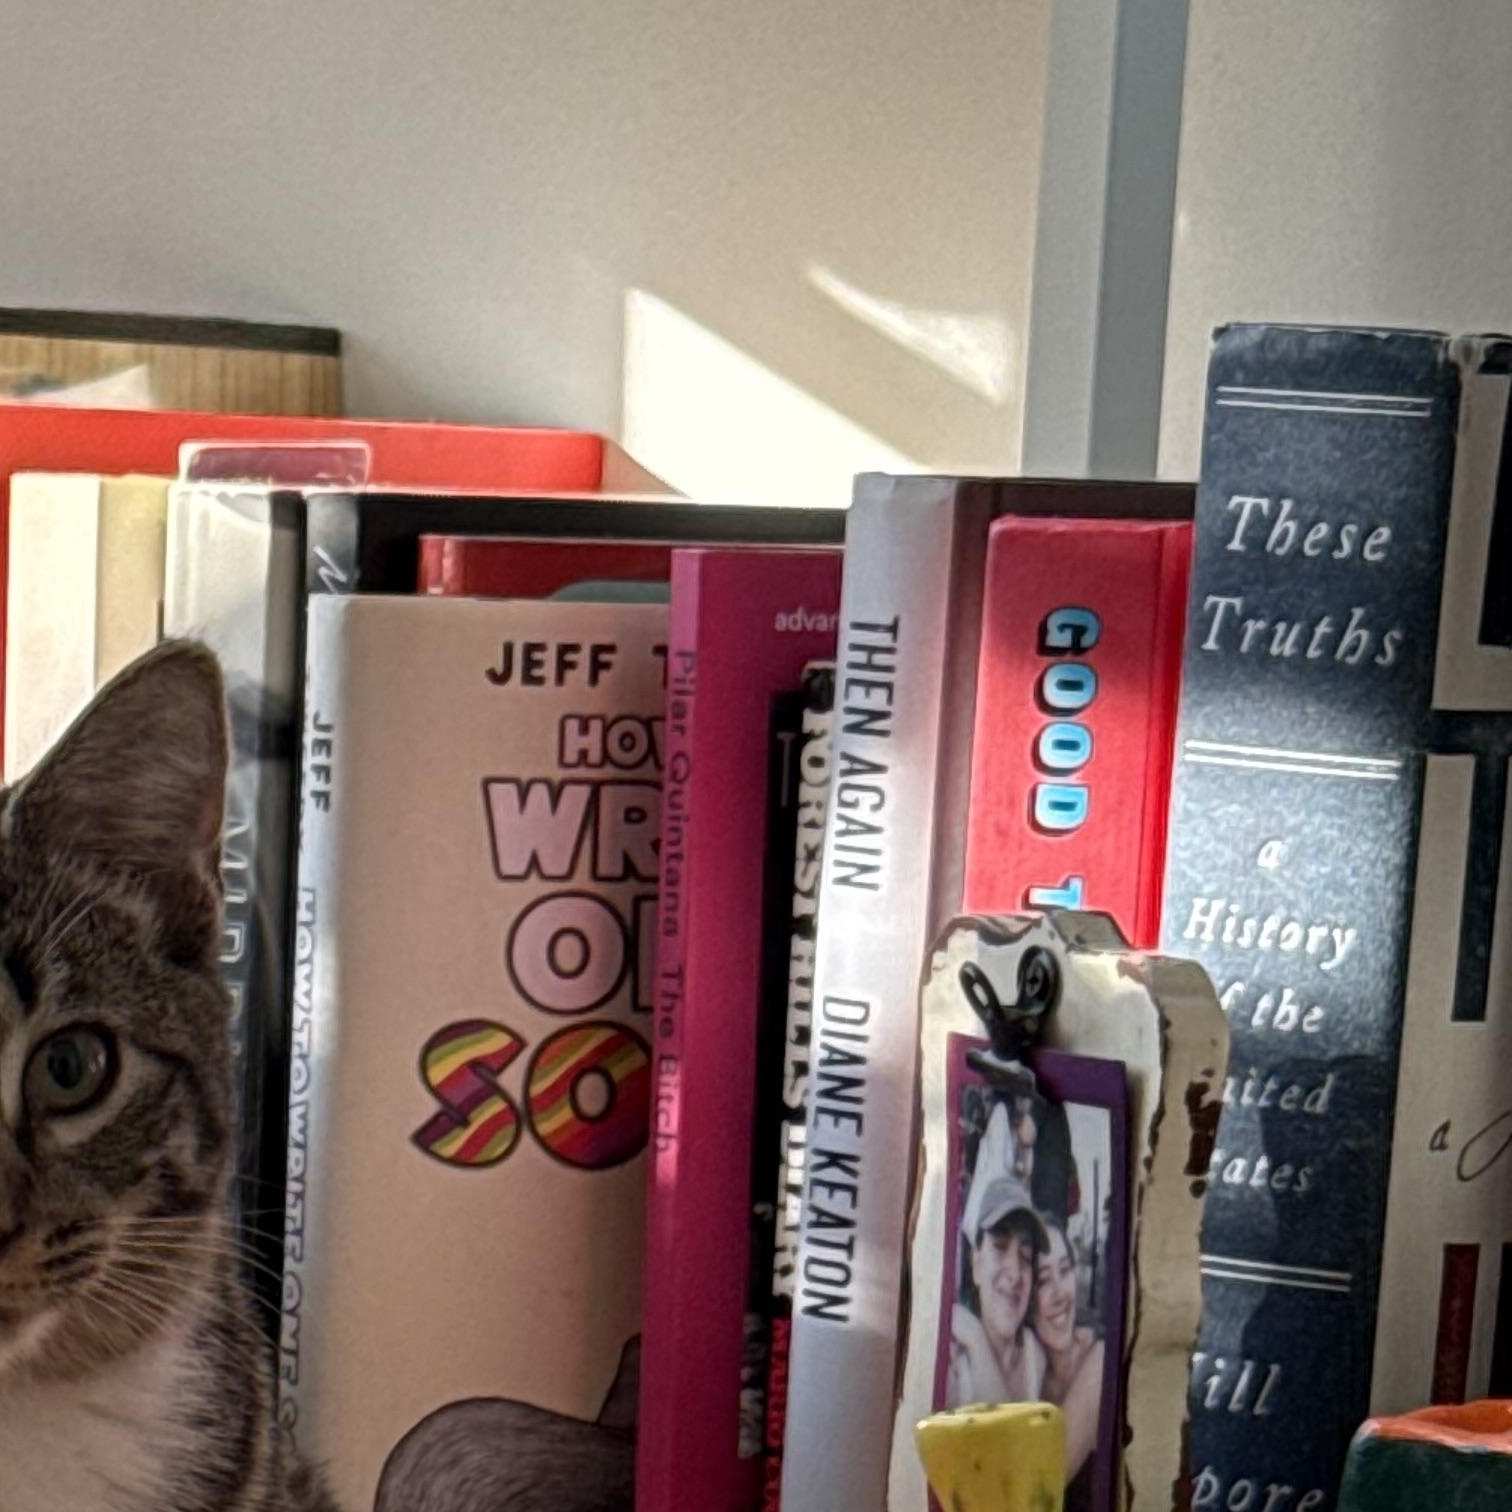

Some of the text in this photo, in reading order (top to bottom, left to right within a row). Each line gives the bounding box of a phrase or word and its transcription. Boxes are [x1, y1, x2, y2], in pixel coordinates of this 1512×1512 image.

[1225, 495, 1392, 560] These
[485, 641, 618, 688] JEFF
[1201, 595, 1404, 668] Truths
[1028, 607, 1100, 838] GOOD
[310, 711, 334, 813] JEFF
[1256, 839, 1286, 870] a
[655, 649, 697, 1154] Pilar Quintana The Bitch
[1183, 897, 1357, 971] History
[800, 614, 900, 1324] THEN AGAIN DIANE KEATON
[1251, 988, 1325, 1034] the
[1223, 1066, 1336, 1114] ited
[1209, 1147, 1314, 1193] ates
